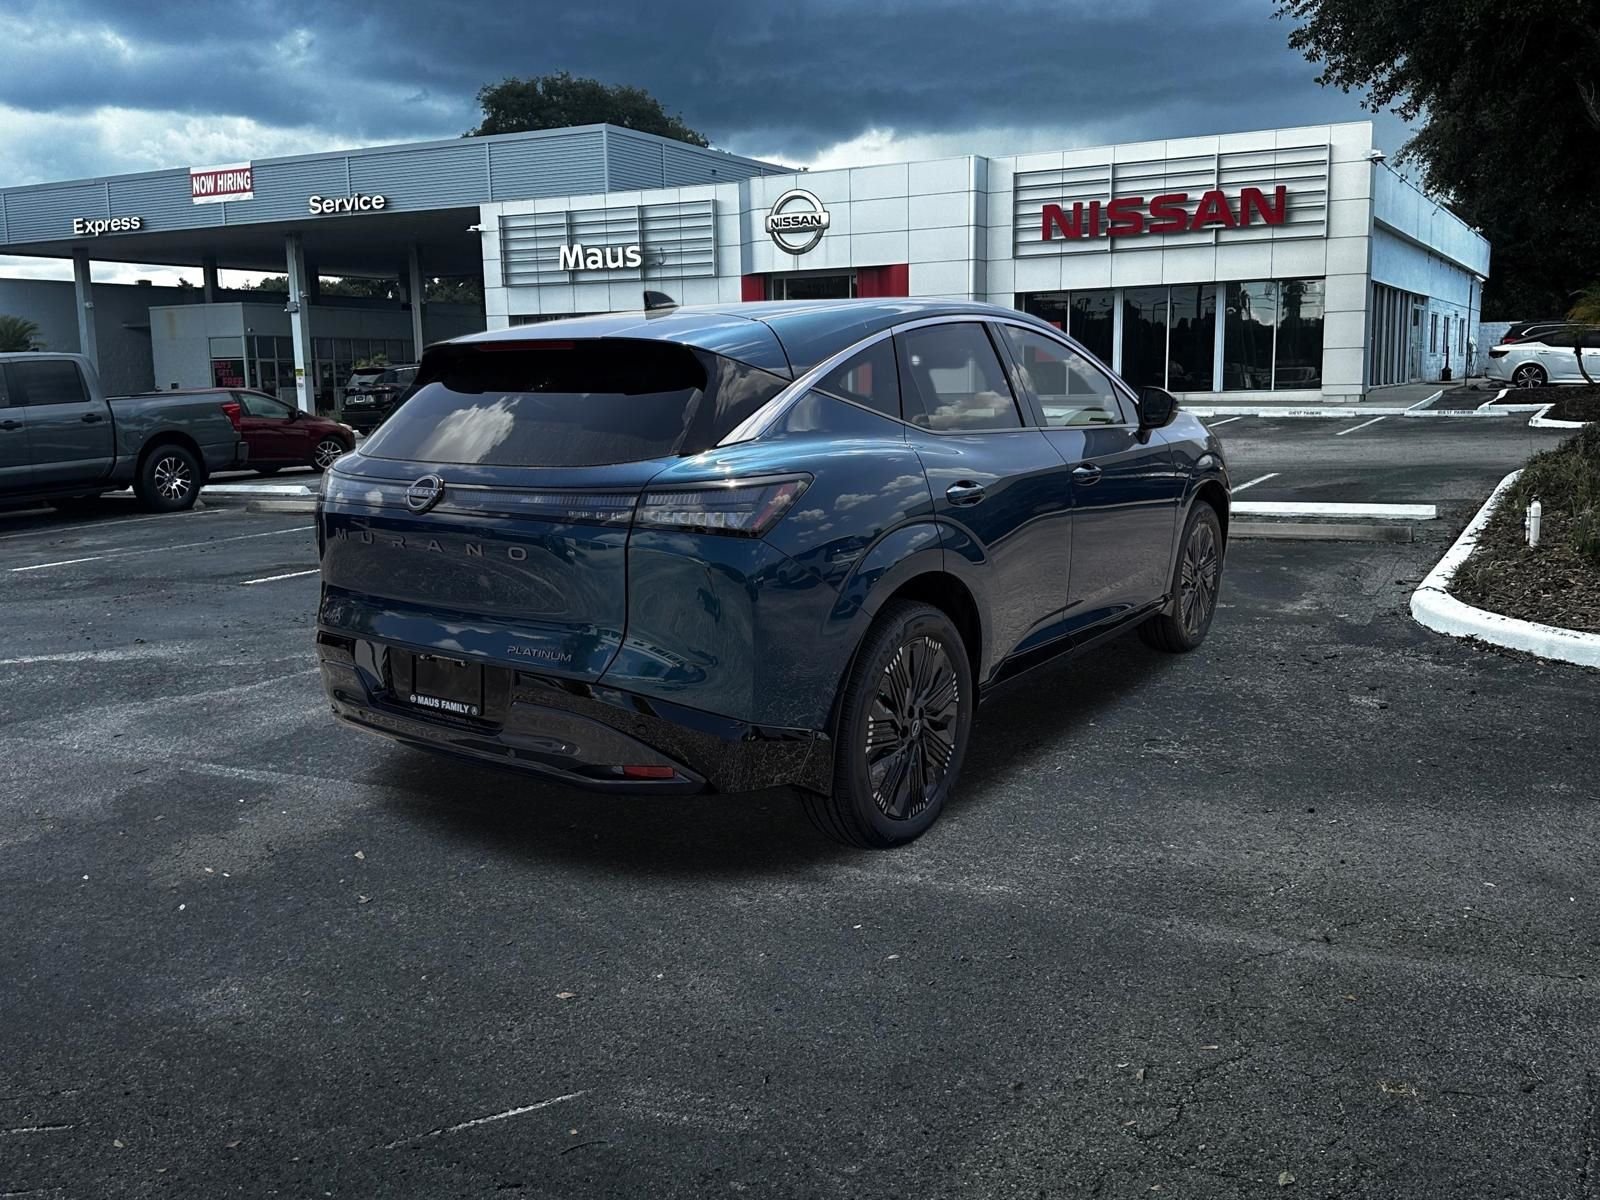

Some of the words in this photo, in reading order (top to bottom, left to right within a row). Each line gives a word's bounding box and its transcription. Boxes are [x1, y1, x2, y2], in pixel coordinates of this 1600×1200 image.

[192, 174, 216, 195] NOW
[216, 170, 251, 193] HIRING
[309, 193, 385, 214] Service
[1042, 186, 1286, 240] NISSAN
[73, 215, 141, 236] Express
[771, 214, 822, 229] NISSAN
[559, 244, 642, 270] Maus
[223, 377, 243, 385] FREE
[335, 528, 527, 561] MURANO
[507, 645, 572, 662] PLATINUM
[417, 695, 440, 708] MAUS
[440, 700, 470, 714] FAMILY
